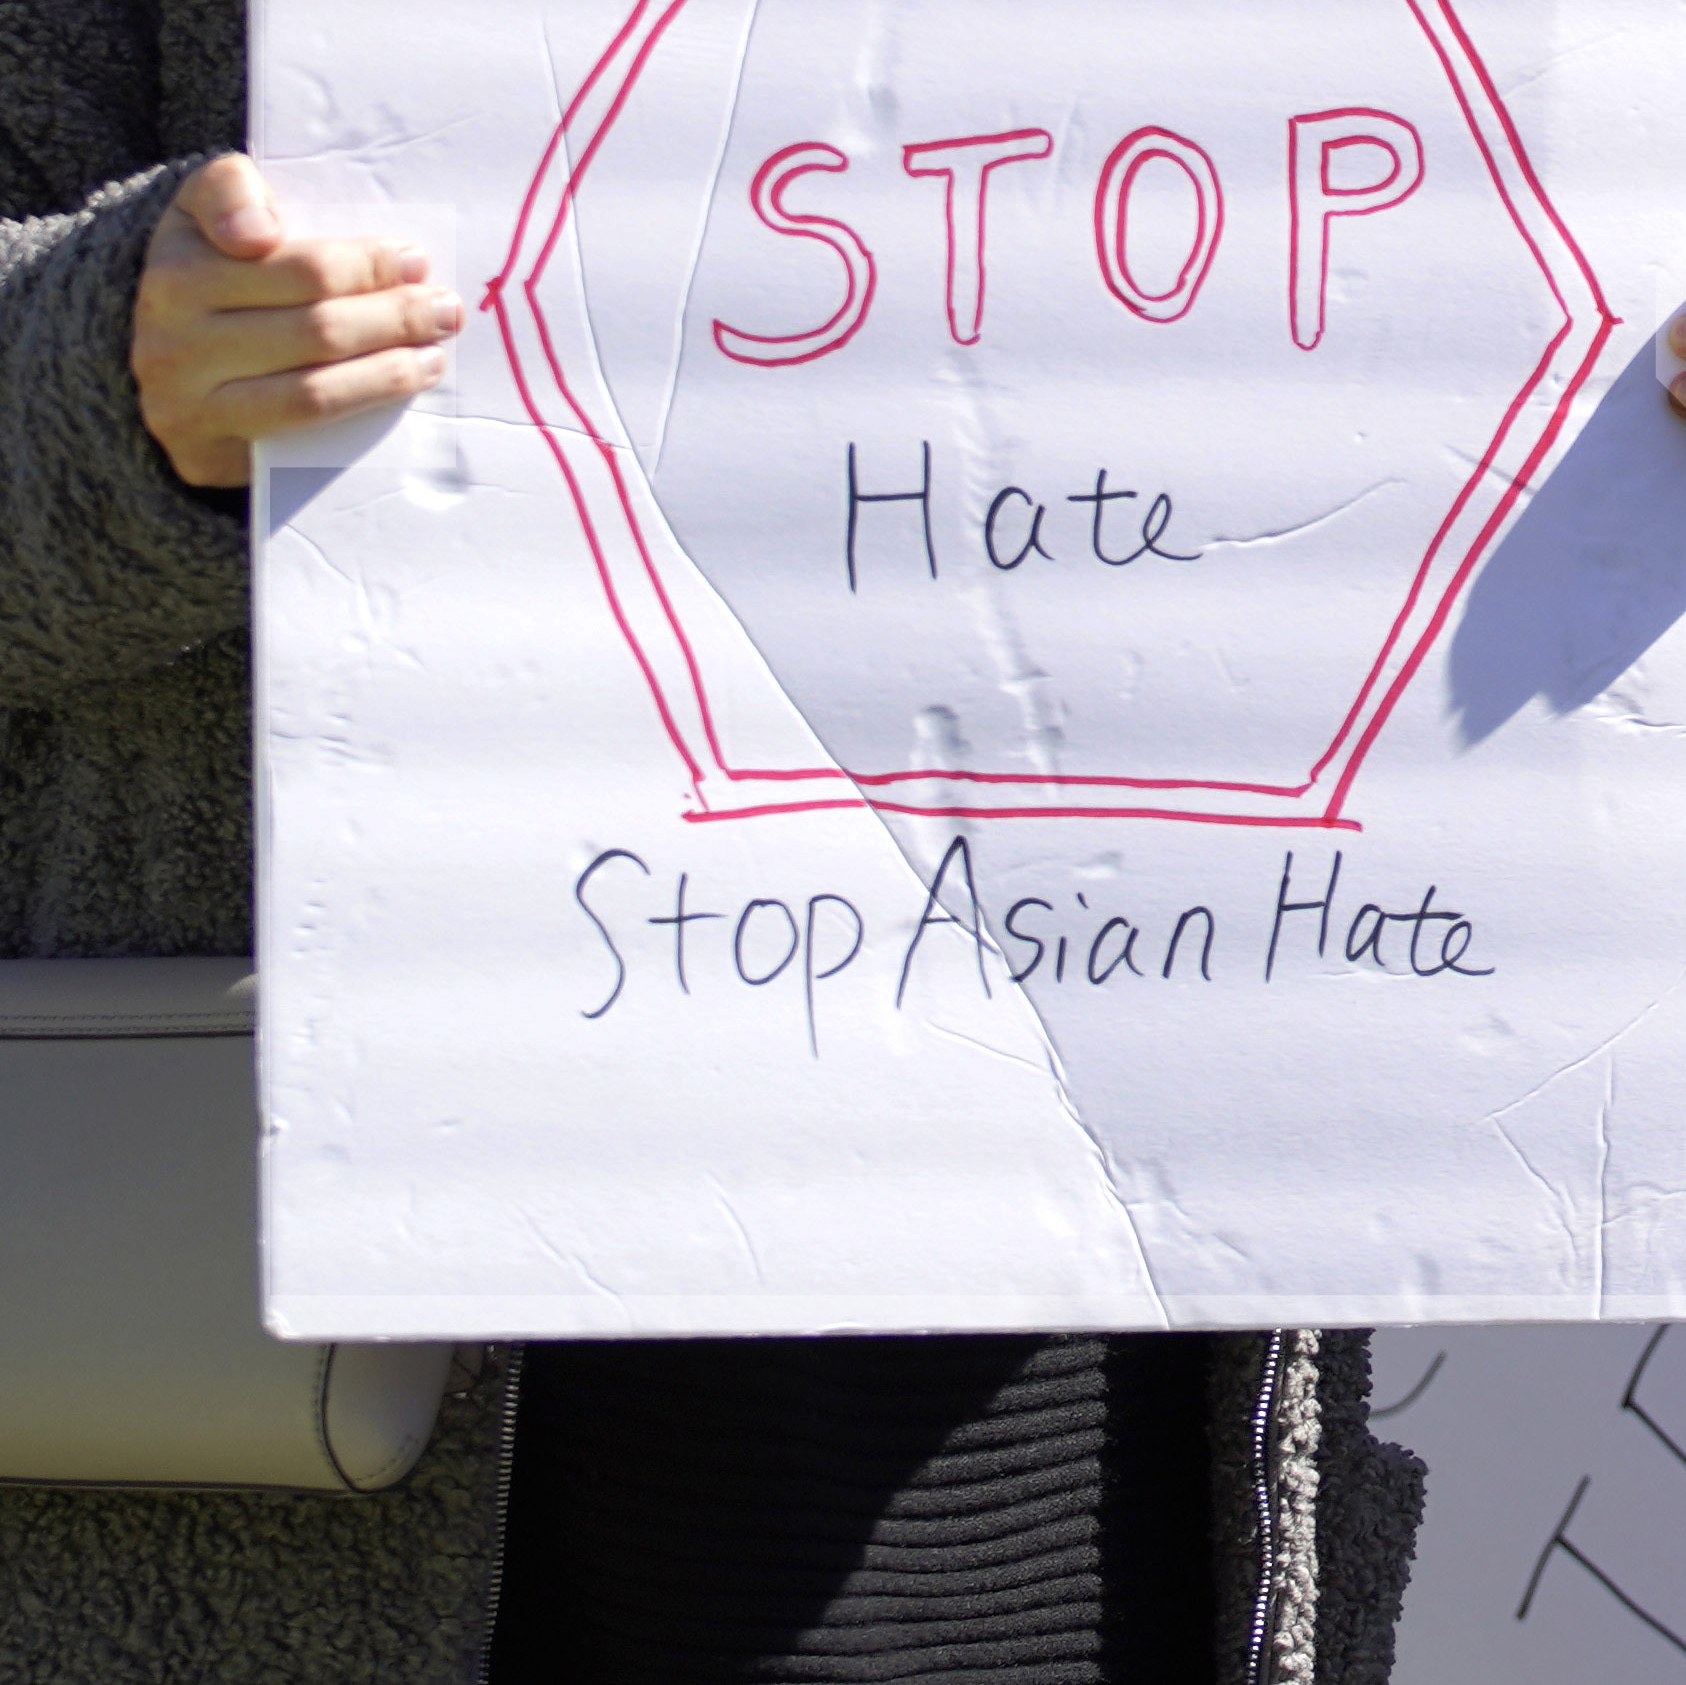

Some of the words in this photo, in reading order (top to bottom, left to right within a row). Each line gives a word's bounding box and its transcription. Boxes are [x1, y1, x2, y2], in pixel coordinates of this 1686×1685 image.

[712, 107, 1425, 367] STOP
[847, 441, 1203, 593] Hate
[576, 849, 864, 1056] Stop
[897, 836, 1214, 1004] Asian
[1266, 850, 1495, 982] Hate
